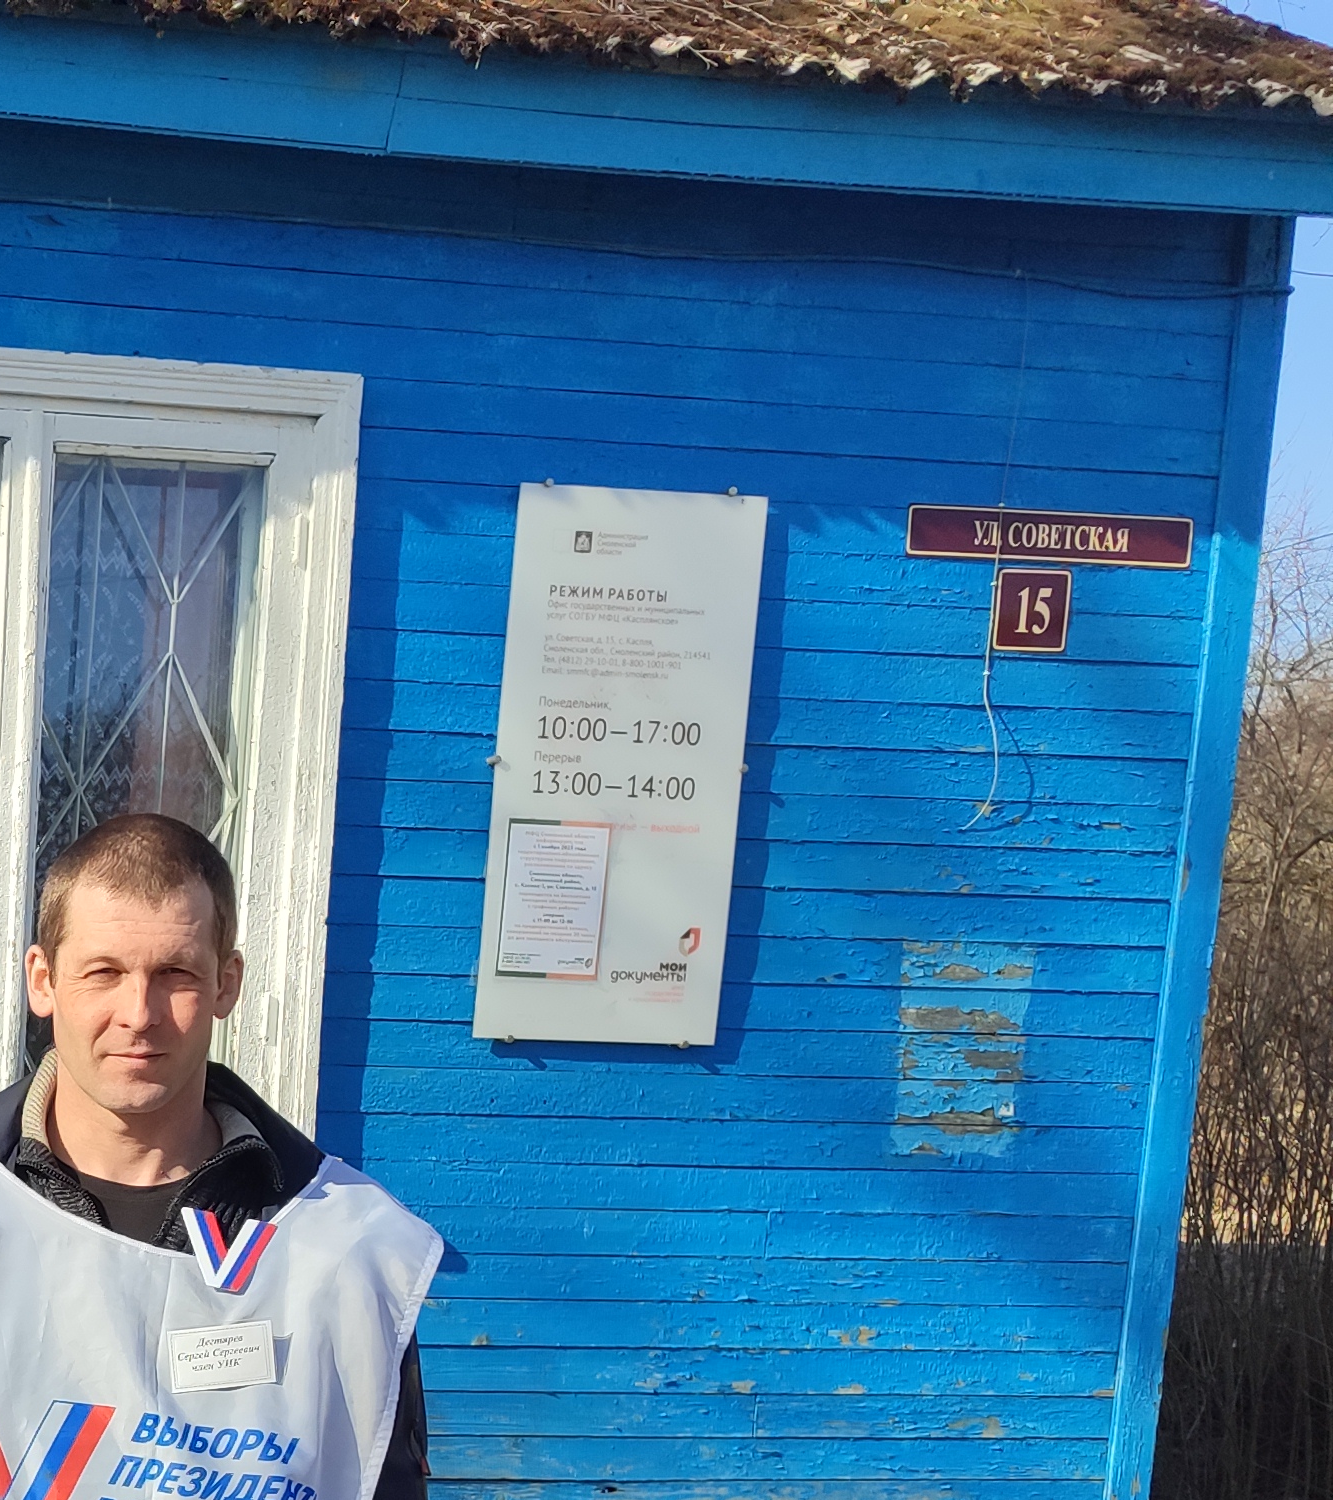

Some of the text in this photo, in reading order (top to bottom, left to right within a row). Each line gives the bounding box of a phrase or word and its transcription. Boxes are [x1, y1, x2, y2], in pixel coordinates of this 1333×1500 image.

[1008, 521, 1130, 553] СОВЕТСКАЯ
[549, 584, 668, 602] РЕЖИМ РАБОТЫ
[1014, 586, 1053, 635] 15
[539, 696, 612, 711] Понедельник,
[534, 750, 582, 764] Перерыв
[178, 1350, 210, 1362] Сергей
[131, 1413, 301, 1465] ВЫБОРЫ
